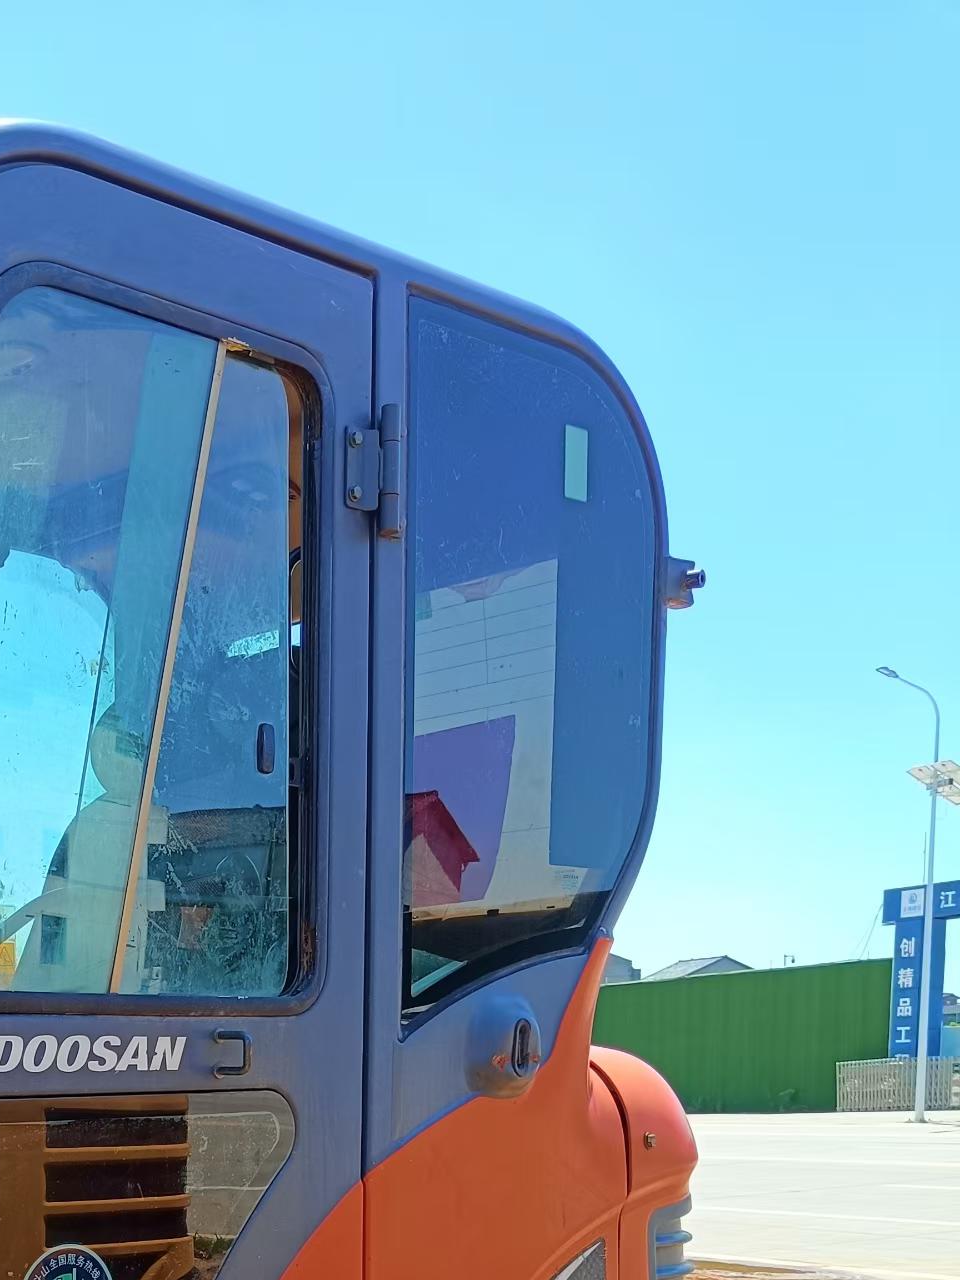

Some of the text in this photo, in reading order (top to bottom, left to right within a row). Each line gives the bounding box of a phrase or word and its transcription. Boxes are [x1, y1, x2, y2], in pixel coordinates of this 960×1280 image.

[940, 891, 957, 908] 江
[895, 937, 915, 1060] 创精品工
